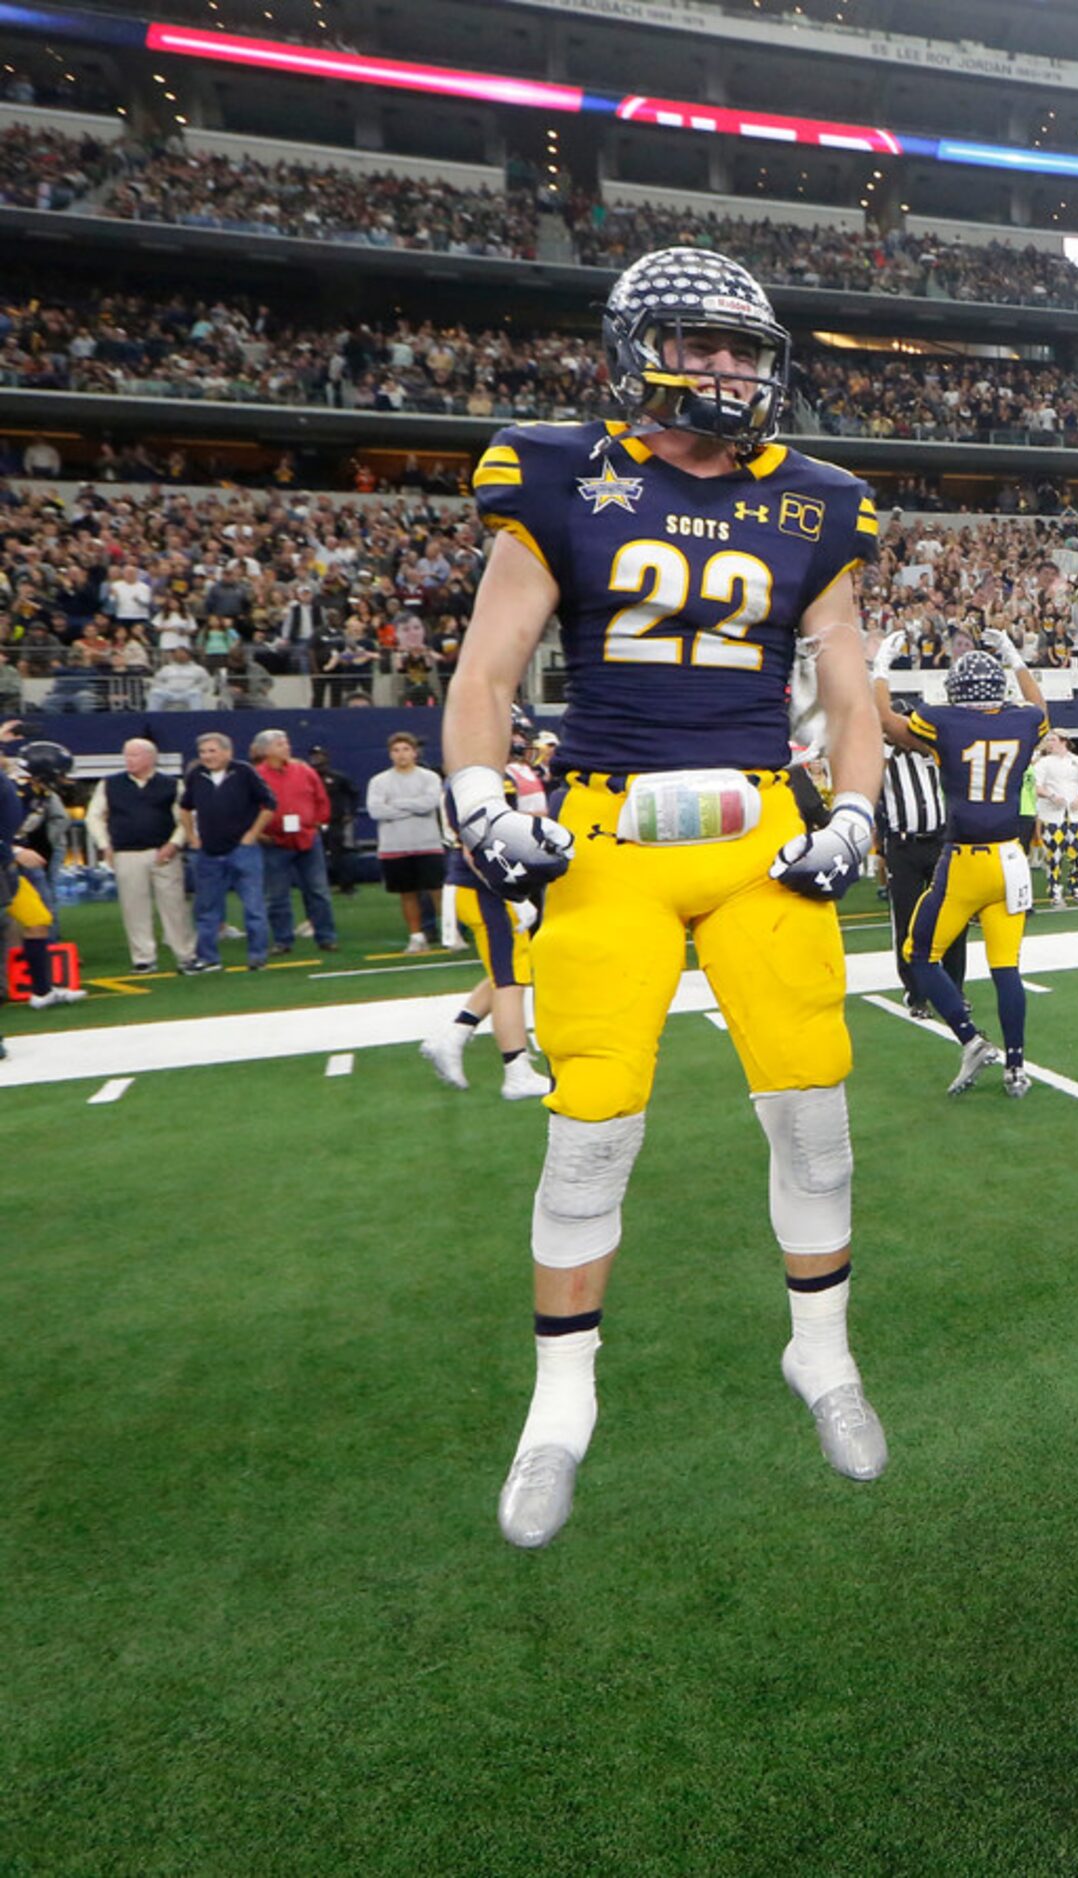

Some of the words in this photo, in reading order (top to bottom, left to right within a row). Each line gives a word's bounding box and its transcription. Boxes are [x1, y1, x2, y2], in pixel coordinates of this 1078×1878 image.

[896, 47, 921, 62] LEE
[959, 57, 1012, 76] JORDAN
[665, 514, 730, 542] SCOTS
[603, 538, 774, 672] 22
[961, 739, 1021, 803] 17
